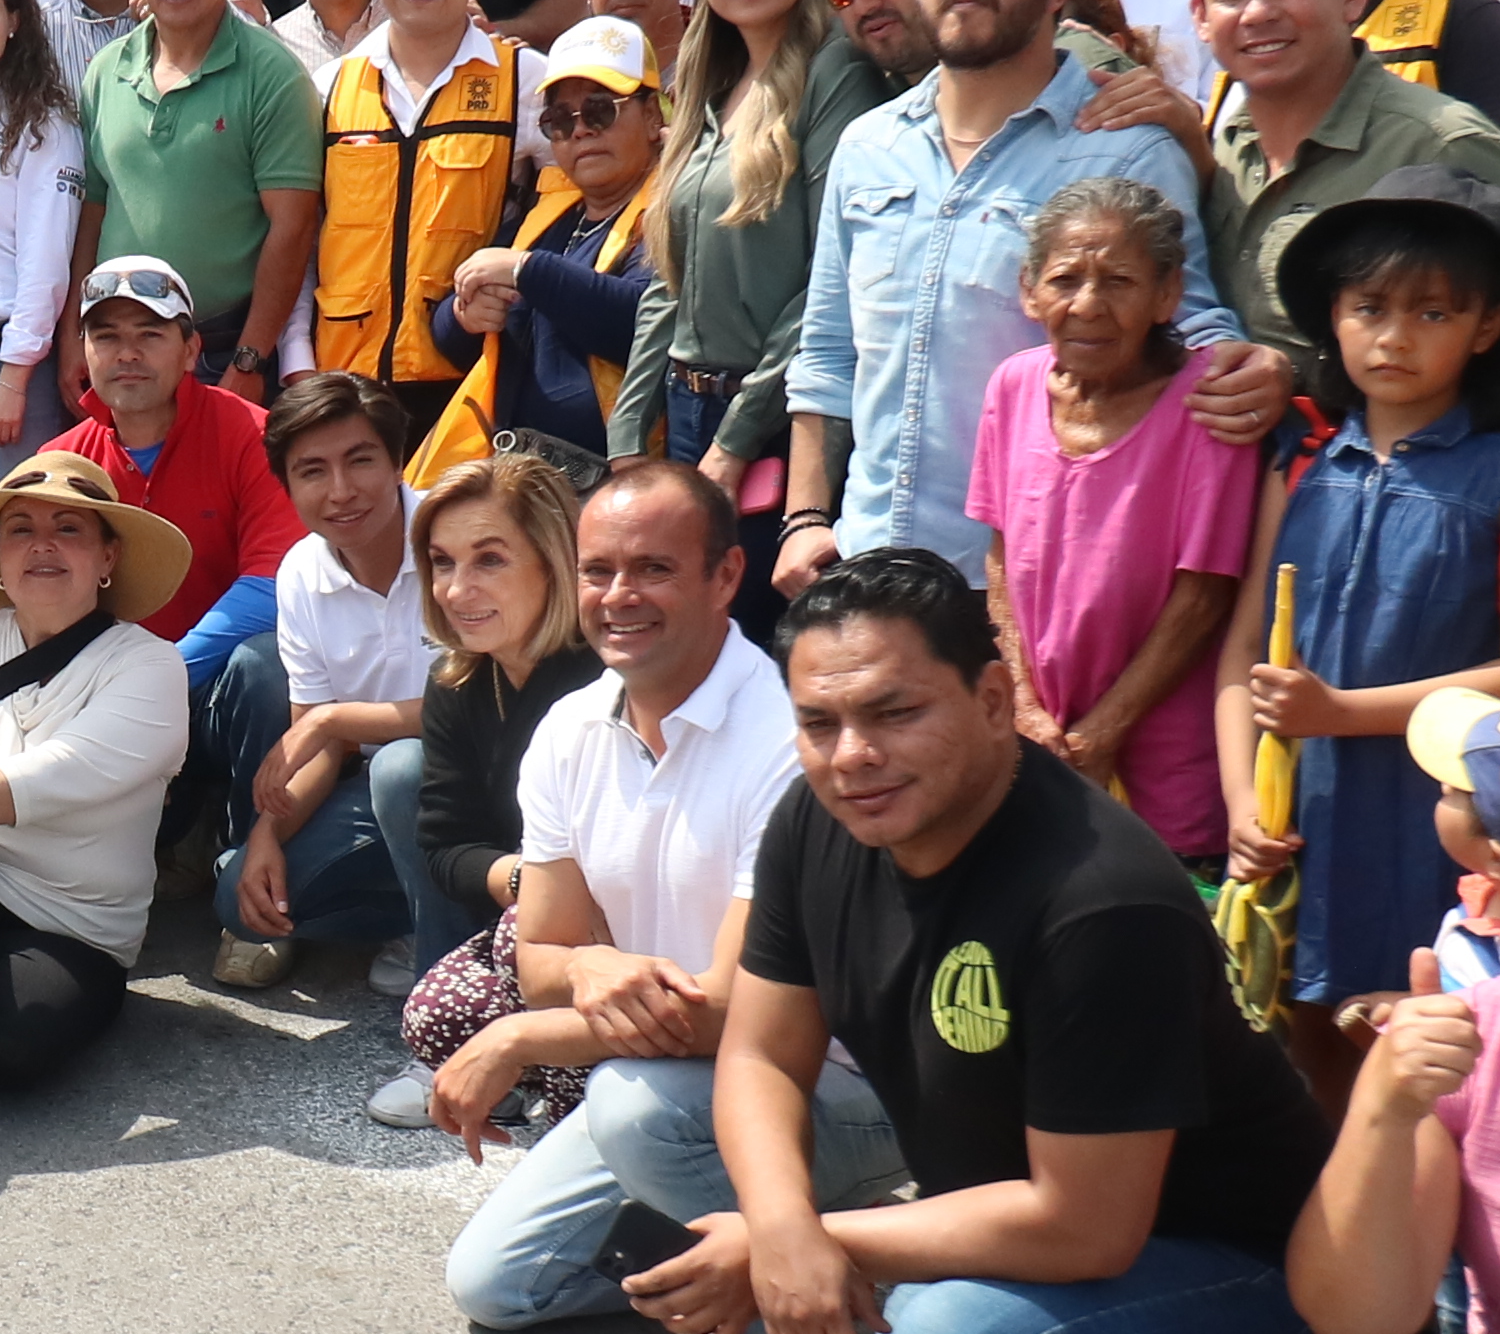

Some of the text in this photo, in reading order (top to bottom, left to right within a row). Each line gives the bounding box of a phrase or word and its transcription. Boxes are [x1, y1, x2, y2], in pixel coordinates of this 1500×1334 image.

[467, 100, 489, 110] PRD
[954, 966, 1010, 1022] ALL
[931, 1006, 1009, 1053] BEHIND
